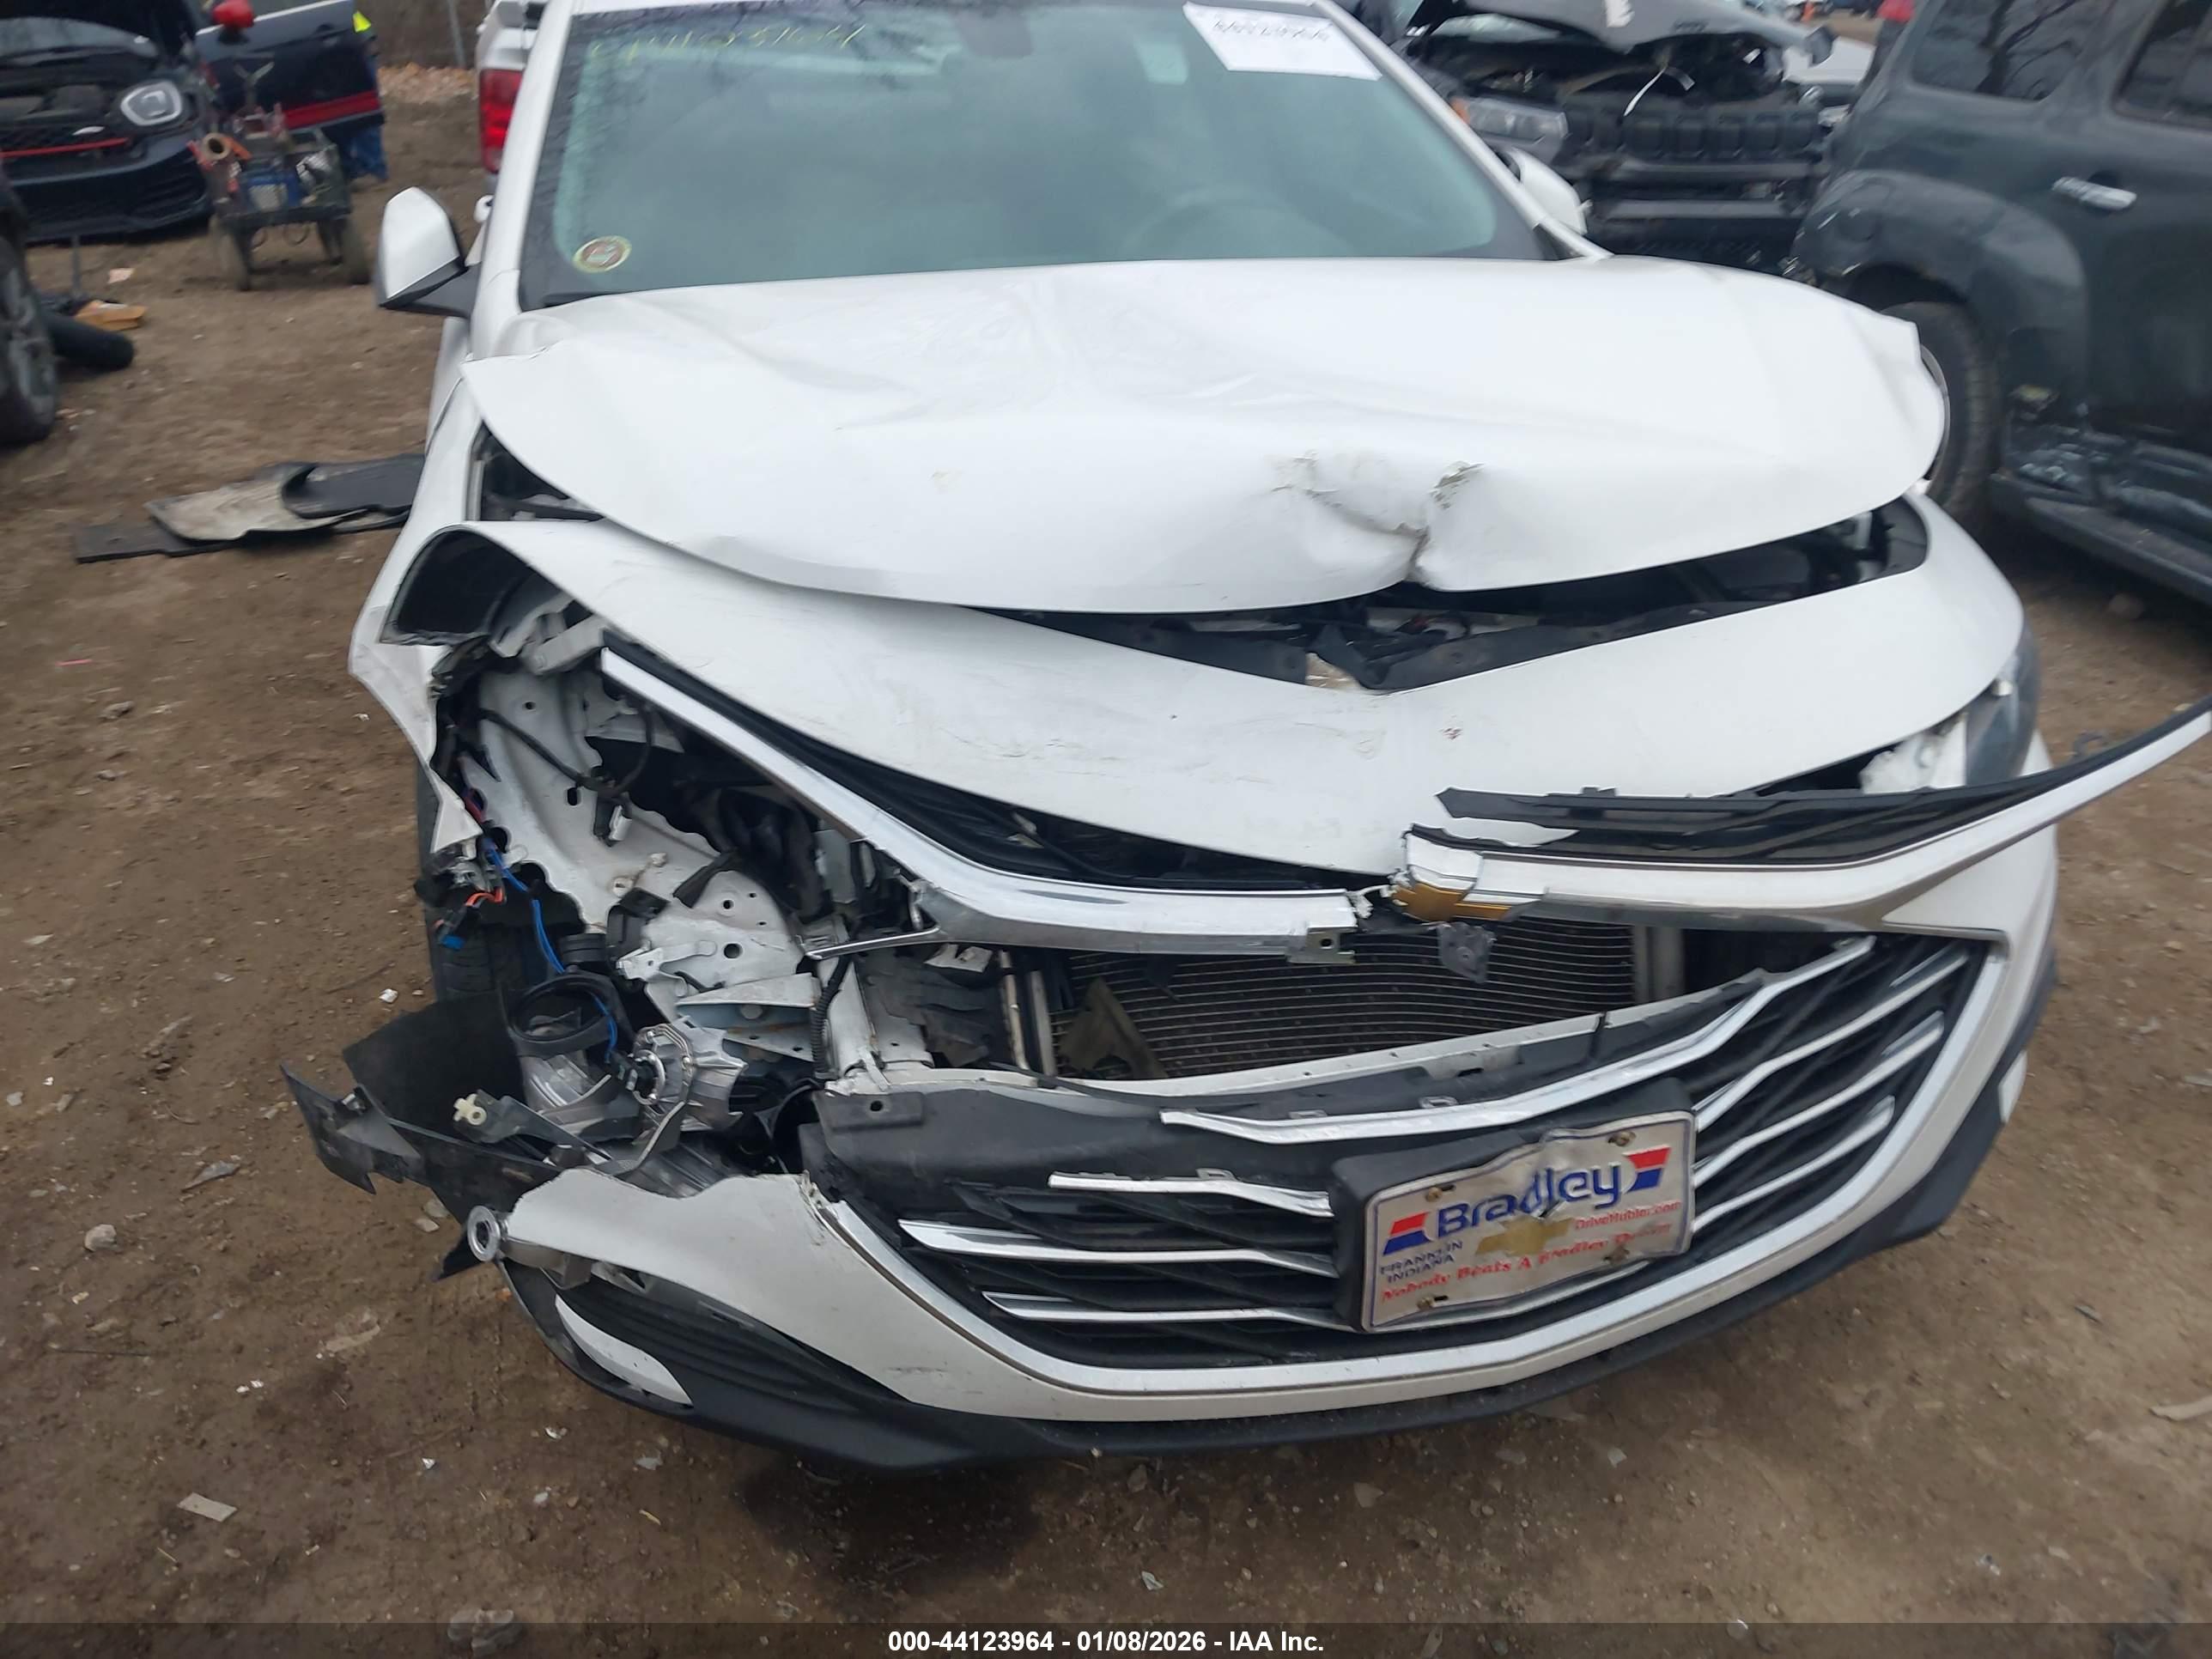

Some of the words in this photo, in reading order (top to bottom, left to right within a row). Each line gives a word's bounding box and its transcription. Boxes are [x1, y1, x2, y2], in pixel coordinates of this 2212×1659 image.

[1437, 1165, 1621, 1238] Bradley
[1380, 1241, 1462, 1274] FRANKIN
[1387, 1255, 1455, 1284] INDIANA
[1517, 1256, 1531, 1269] A
